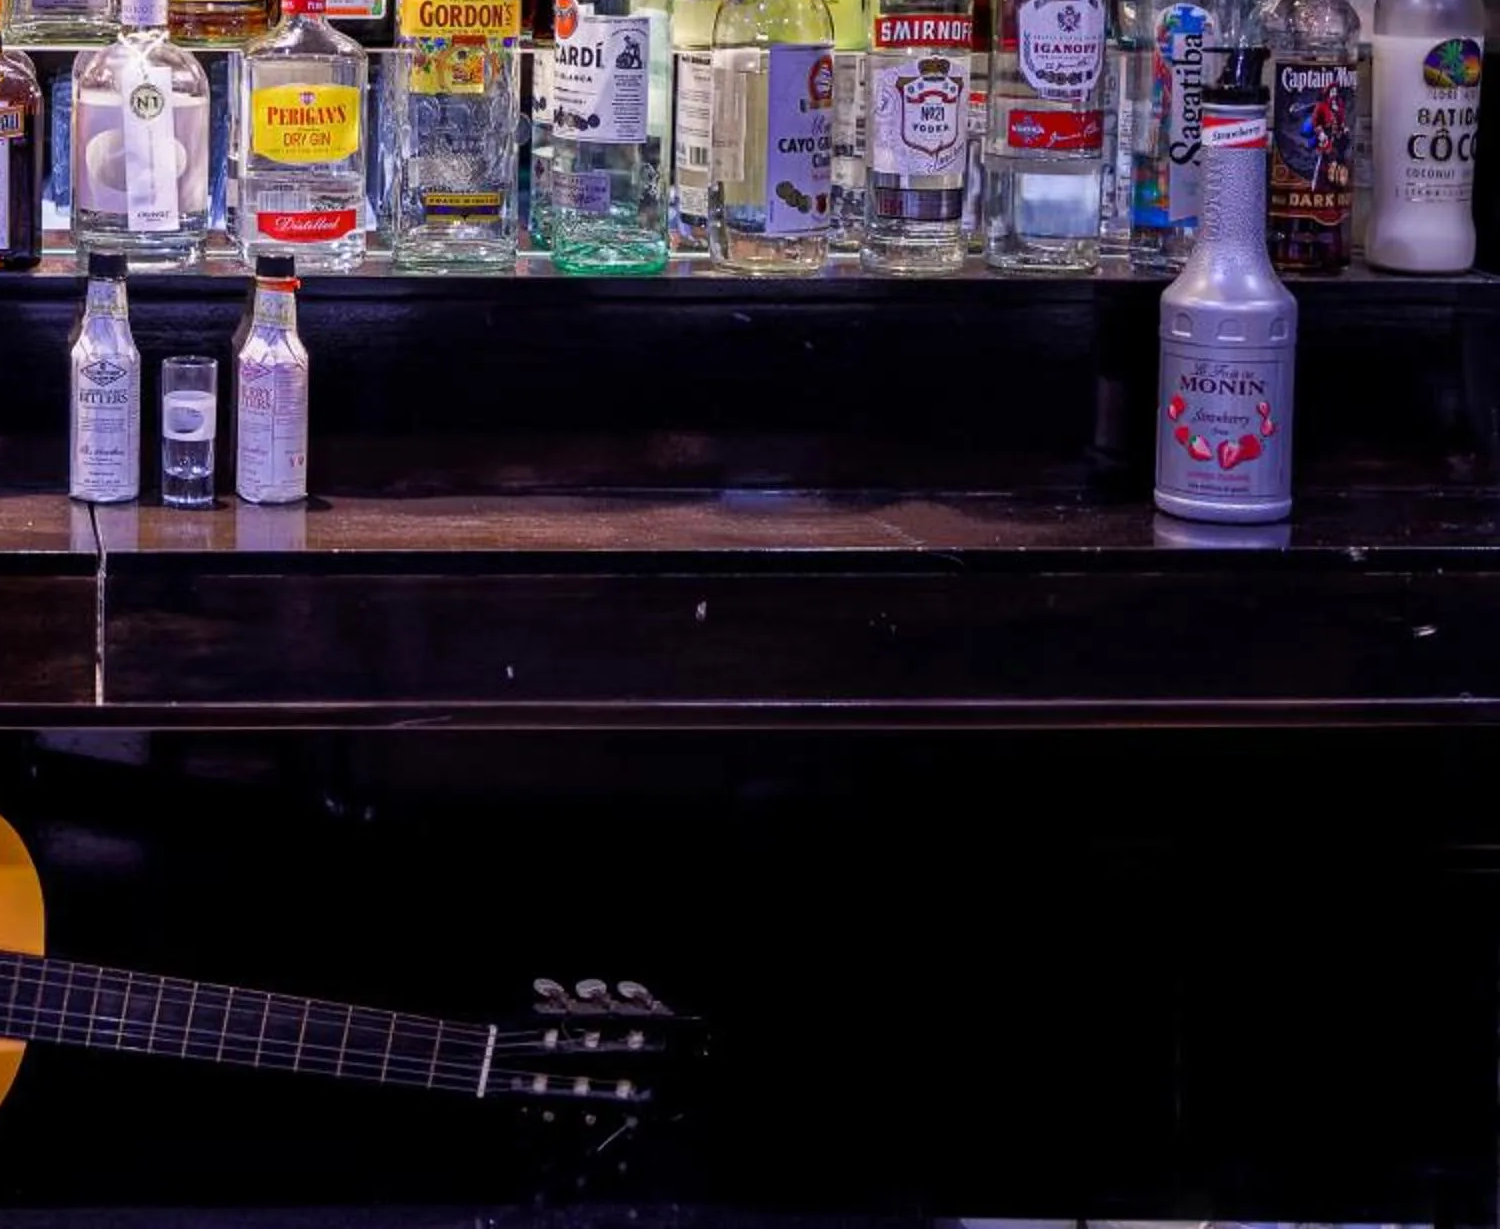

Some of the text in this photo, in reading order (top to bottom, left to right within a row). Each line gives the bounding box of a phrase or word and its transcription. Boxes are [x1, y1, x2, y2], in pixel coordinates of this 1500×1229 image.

[420, 0, 513, 27] GORDON'S
[1281, 66, 1333, 91] Captain
[1169, 34, 1204, 167] Sagatiba
[1417, 108, 1479, 127] BATID
[283, 132, 331, 147] DRY GIN
[778, 138, 815, 153] CAYO
[1289, 192, 1335, 207] DARK
[1180, 374, 1265, 396] MONIN
